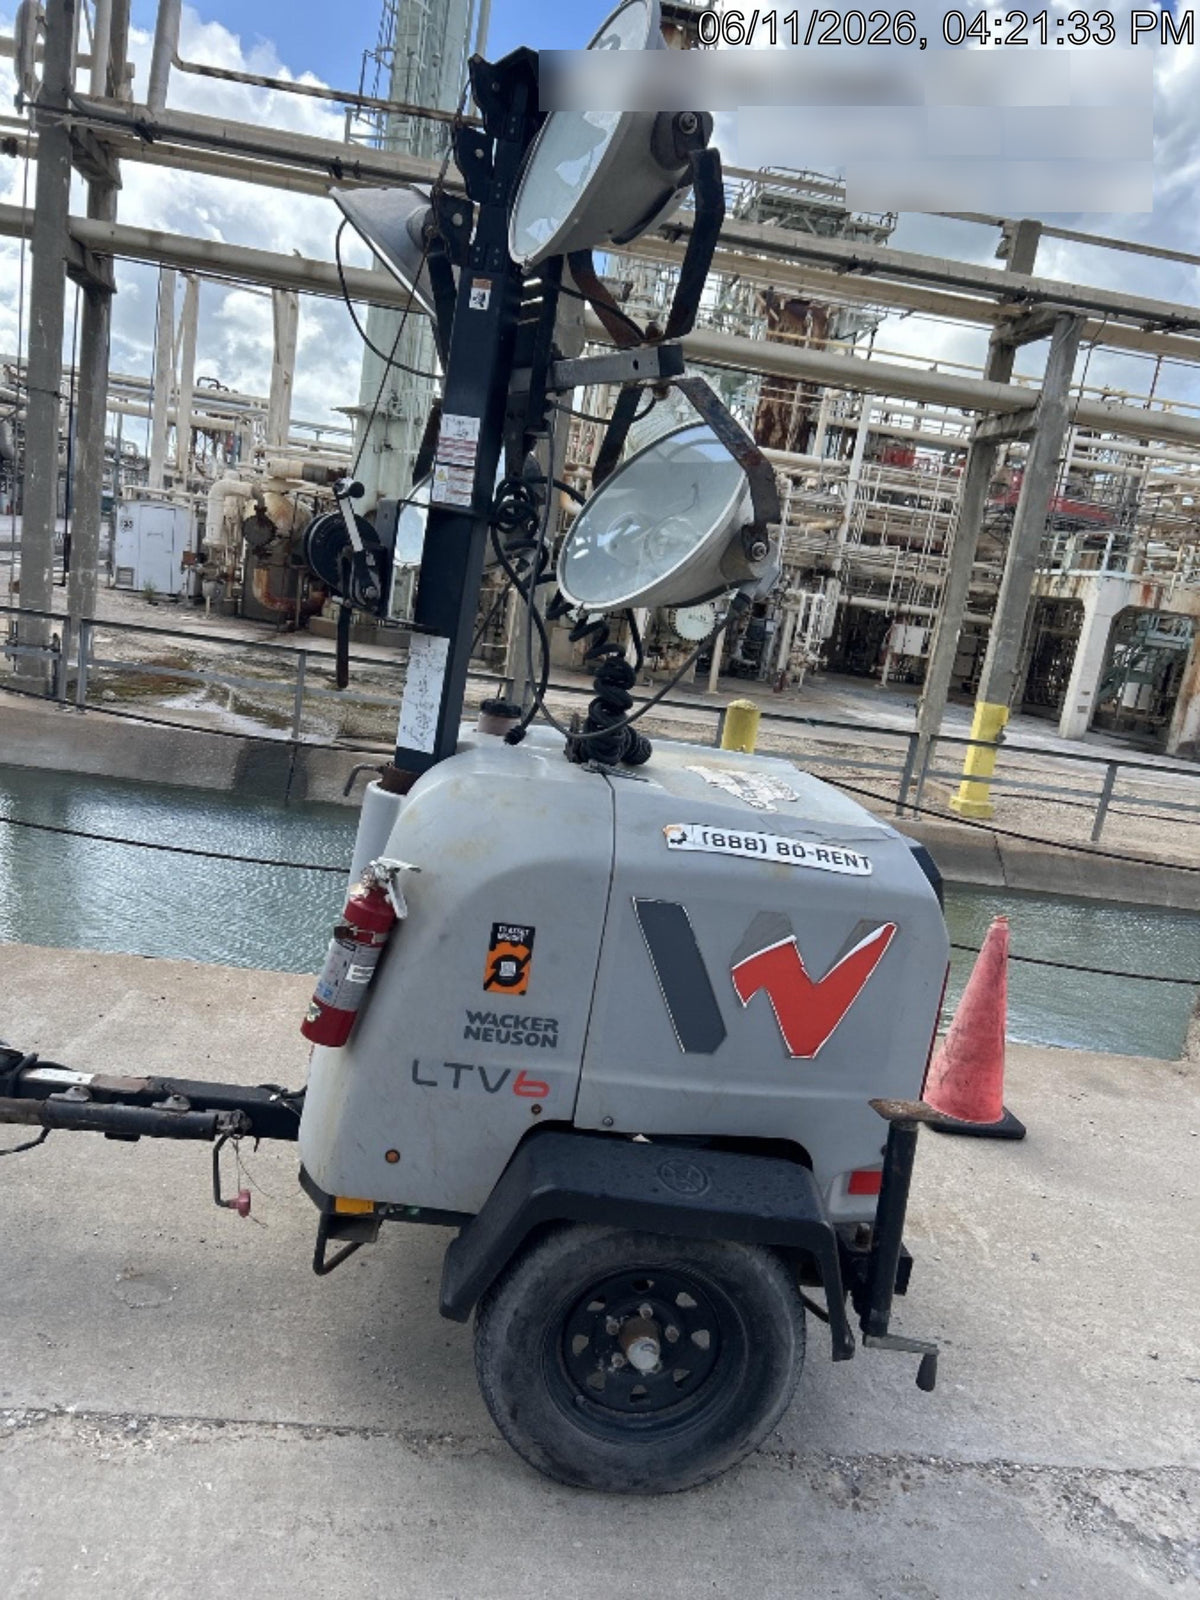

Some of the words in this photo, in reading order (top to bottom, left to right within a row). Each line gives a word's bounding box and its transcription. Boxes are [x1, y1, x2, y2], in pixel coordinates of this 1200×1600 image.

[702, 831, 767, 854] (888)
[465, 1009, 559, 1034] WACKER
[463, 1025, 559, 1048] NEUSON
[411, 1059, 550, 1098] LTV6
